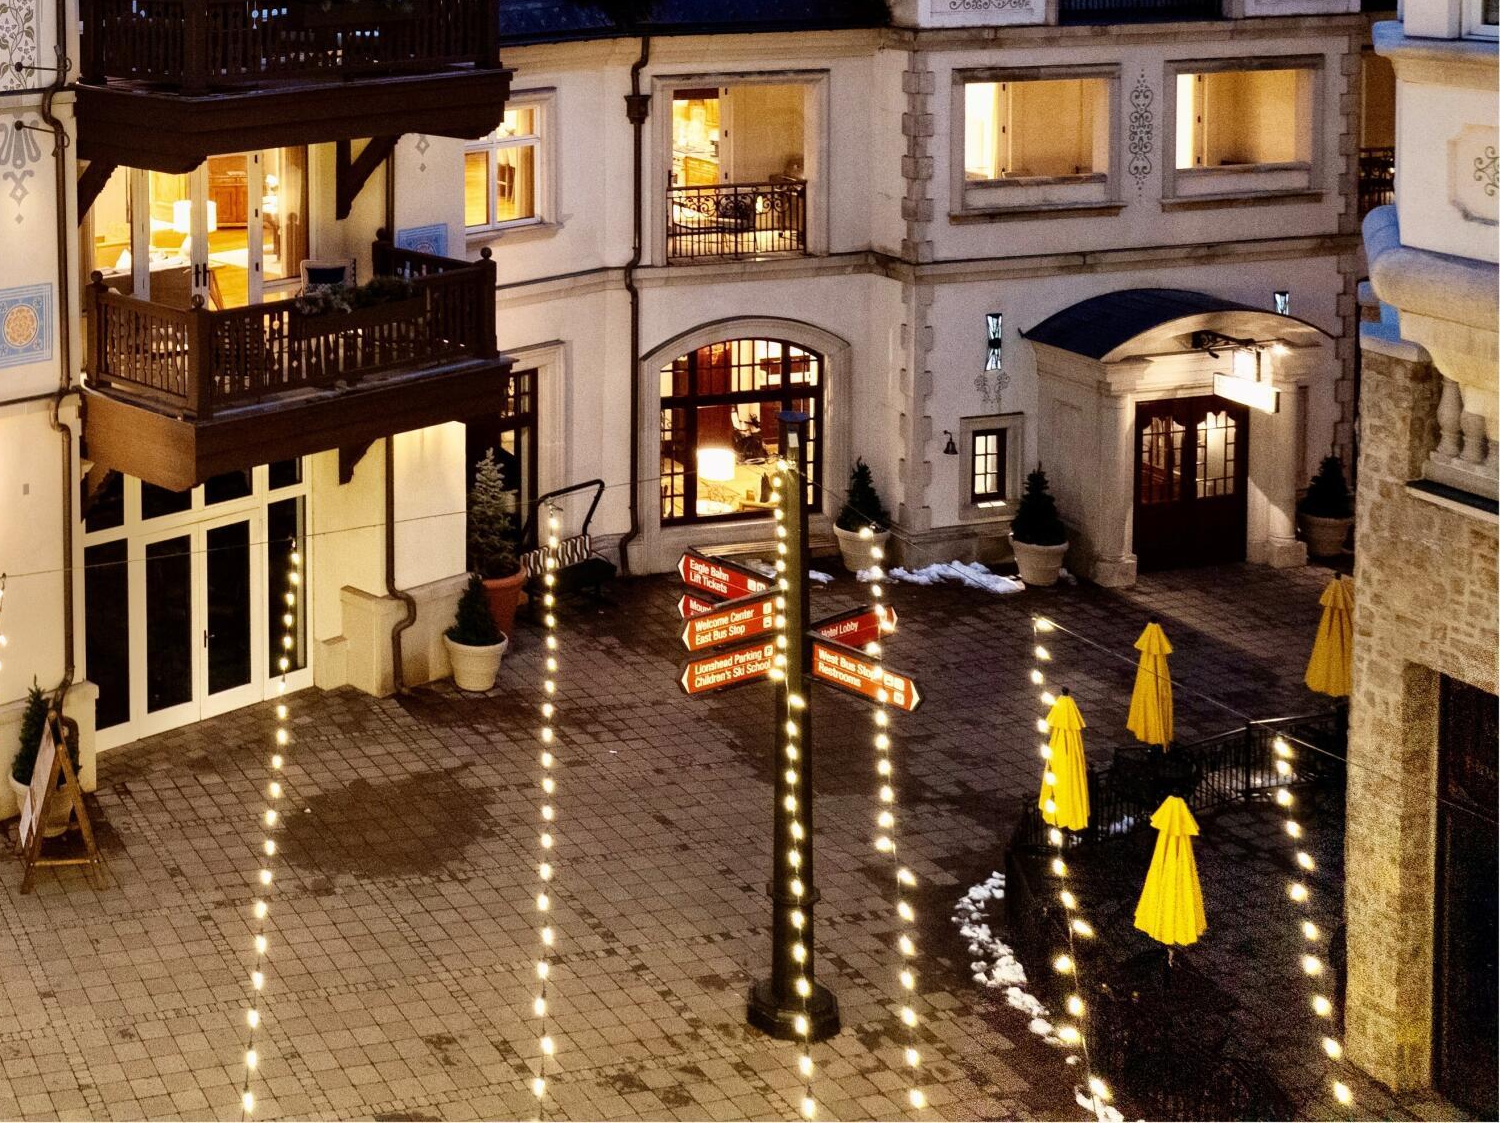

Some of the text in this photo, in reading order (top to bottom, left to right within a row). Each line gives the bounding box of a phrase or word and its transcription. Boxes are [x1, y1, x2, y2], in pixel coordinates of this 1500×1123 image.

[689, 558, 730, 582] Eagle Bahn
[689, 571, 728, 593] Lift Tickets
[694, 609, 755, 632] Welcome Center
[821, 621, 859, 638] Hotel Lobby
[695, 624, 746, 646] East Bus Stop
[694, 656, 733, 675] Lionshead
[734, 649, 762, 665] Parking
[818, 648, 839, 665] West
[840, 657, 856, 671] Bus
[694, 660, 771, 688] Children's Ski School
[818, 662, 862, 687] Restrooms
